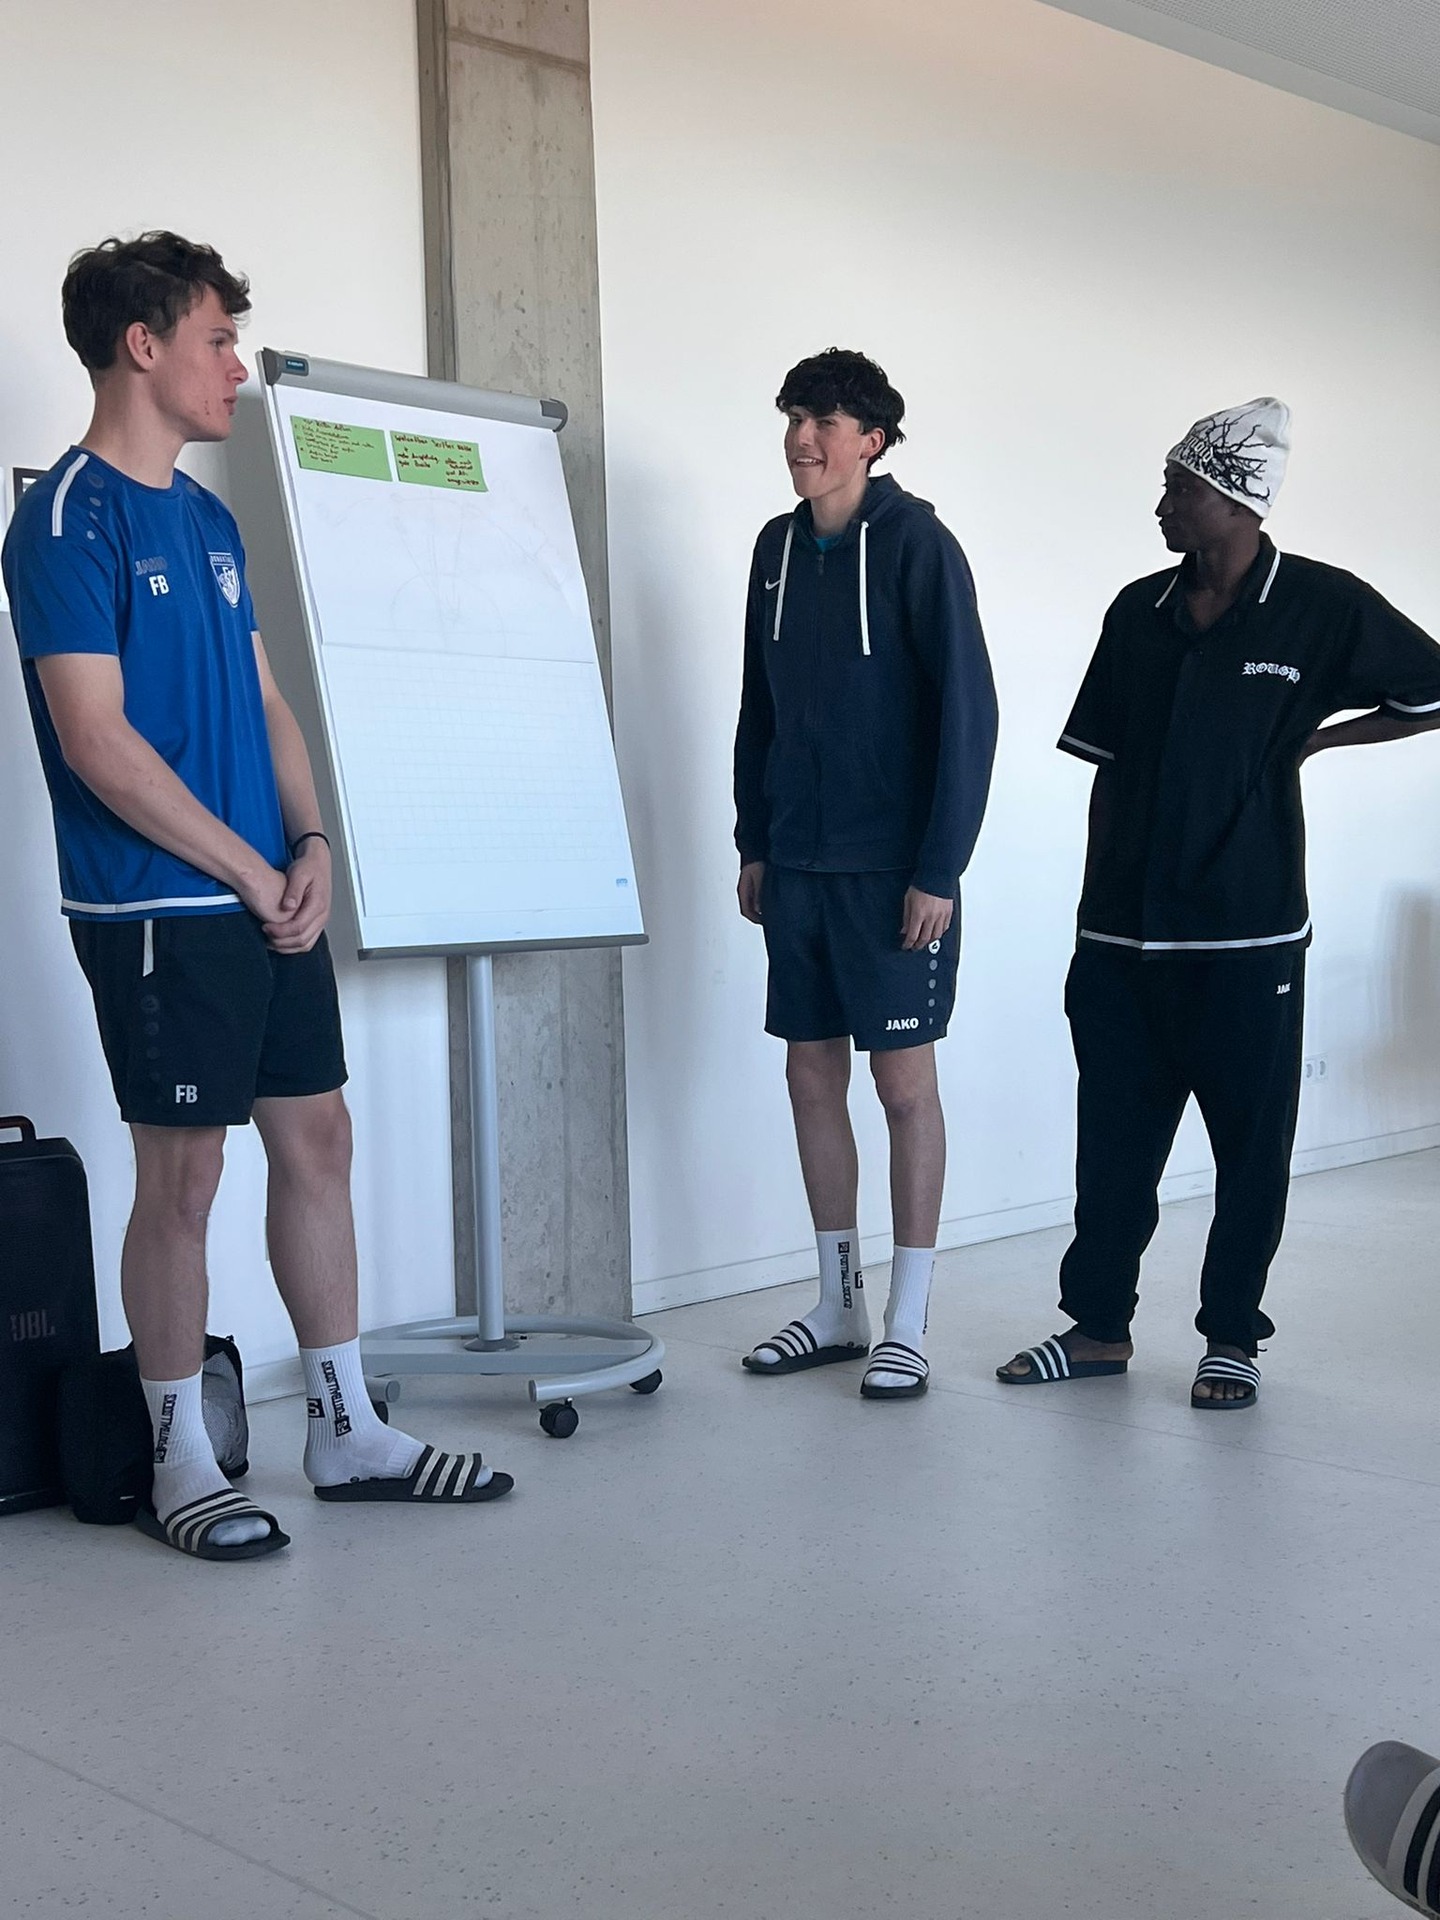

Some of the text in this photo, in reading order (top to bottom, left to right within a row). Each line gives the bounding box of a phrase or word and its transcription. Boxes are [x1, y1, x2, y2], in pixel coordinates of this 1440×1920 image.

[149, 575, 170, 596] FB
[1241, 661, 1301, 684] ROUGH
[885, 1017, 920, 1031] JAKO
[175, 1084, 198, 1104] FB
[12, 1309, 56, 1341] JBL
